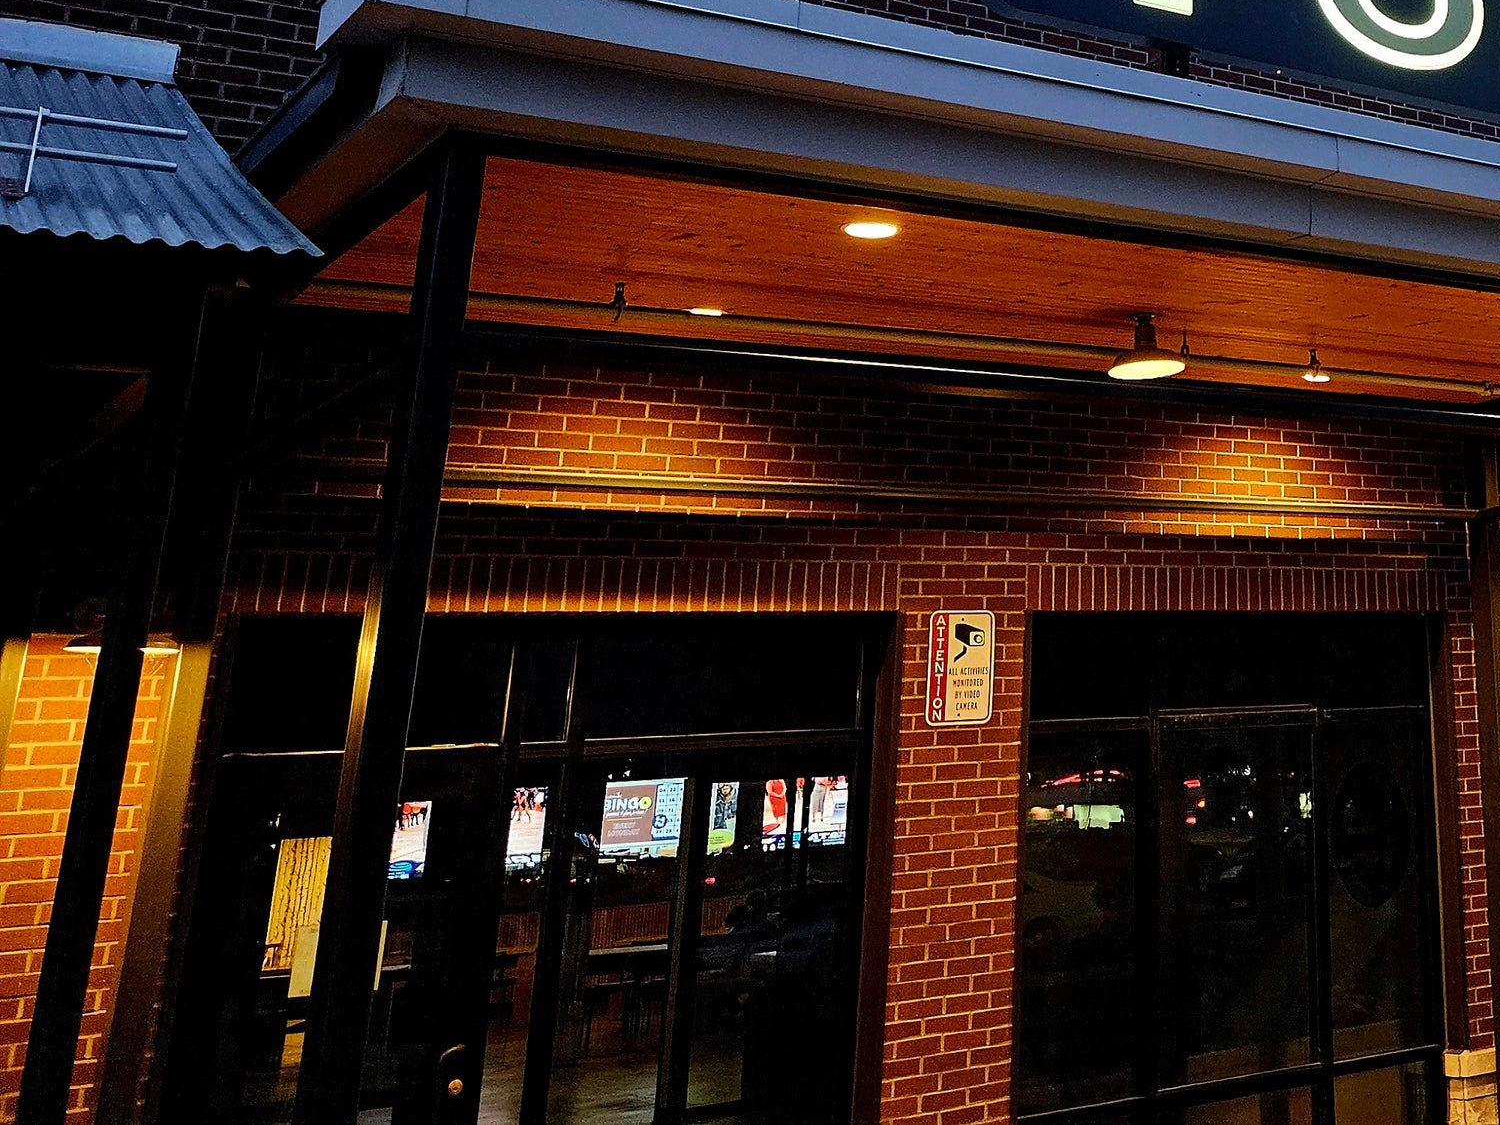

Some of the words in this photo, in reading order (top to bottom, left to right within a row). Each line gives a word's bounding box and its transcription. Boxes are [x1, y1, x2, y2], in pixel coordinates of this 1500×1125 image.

[931, 615, 947, 721] ATTENTION
[949, 668, 958, 676] ALL
[960, 667, 989, 675] ACTIVITIES
[952, 678, 984, 687] MONITORED
[955, 691, 963, 699] BY
[964, 690, 981, 699] VIDEO
[955, 702, 978, 711] CAMERA
[604, 796, 653, 812] BINGO
